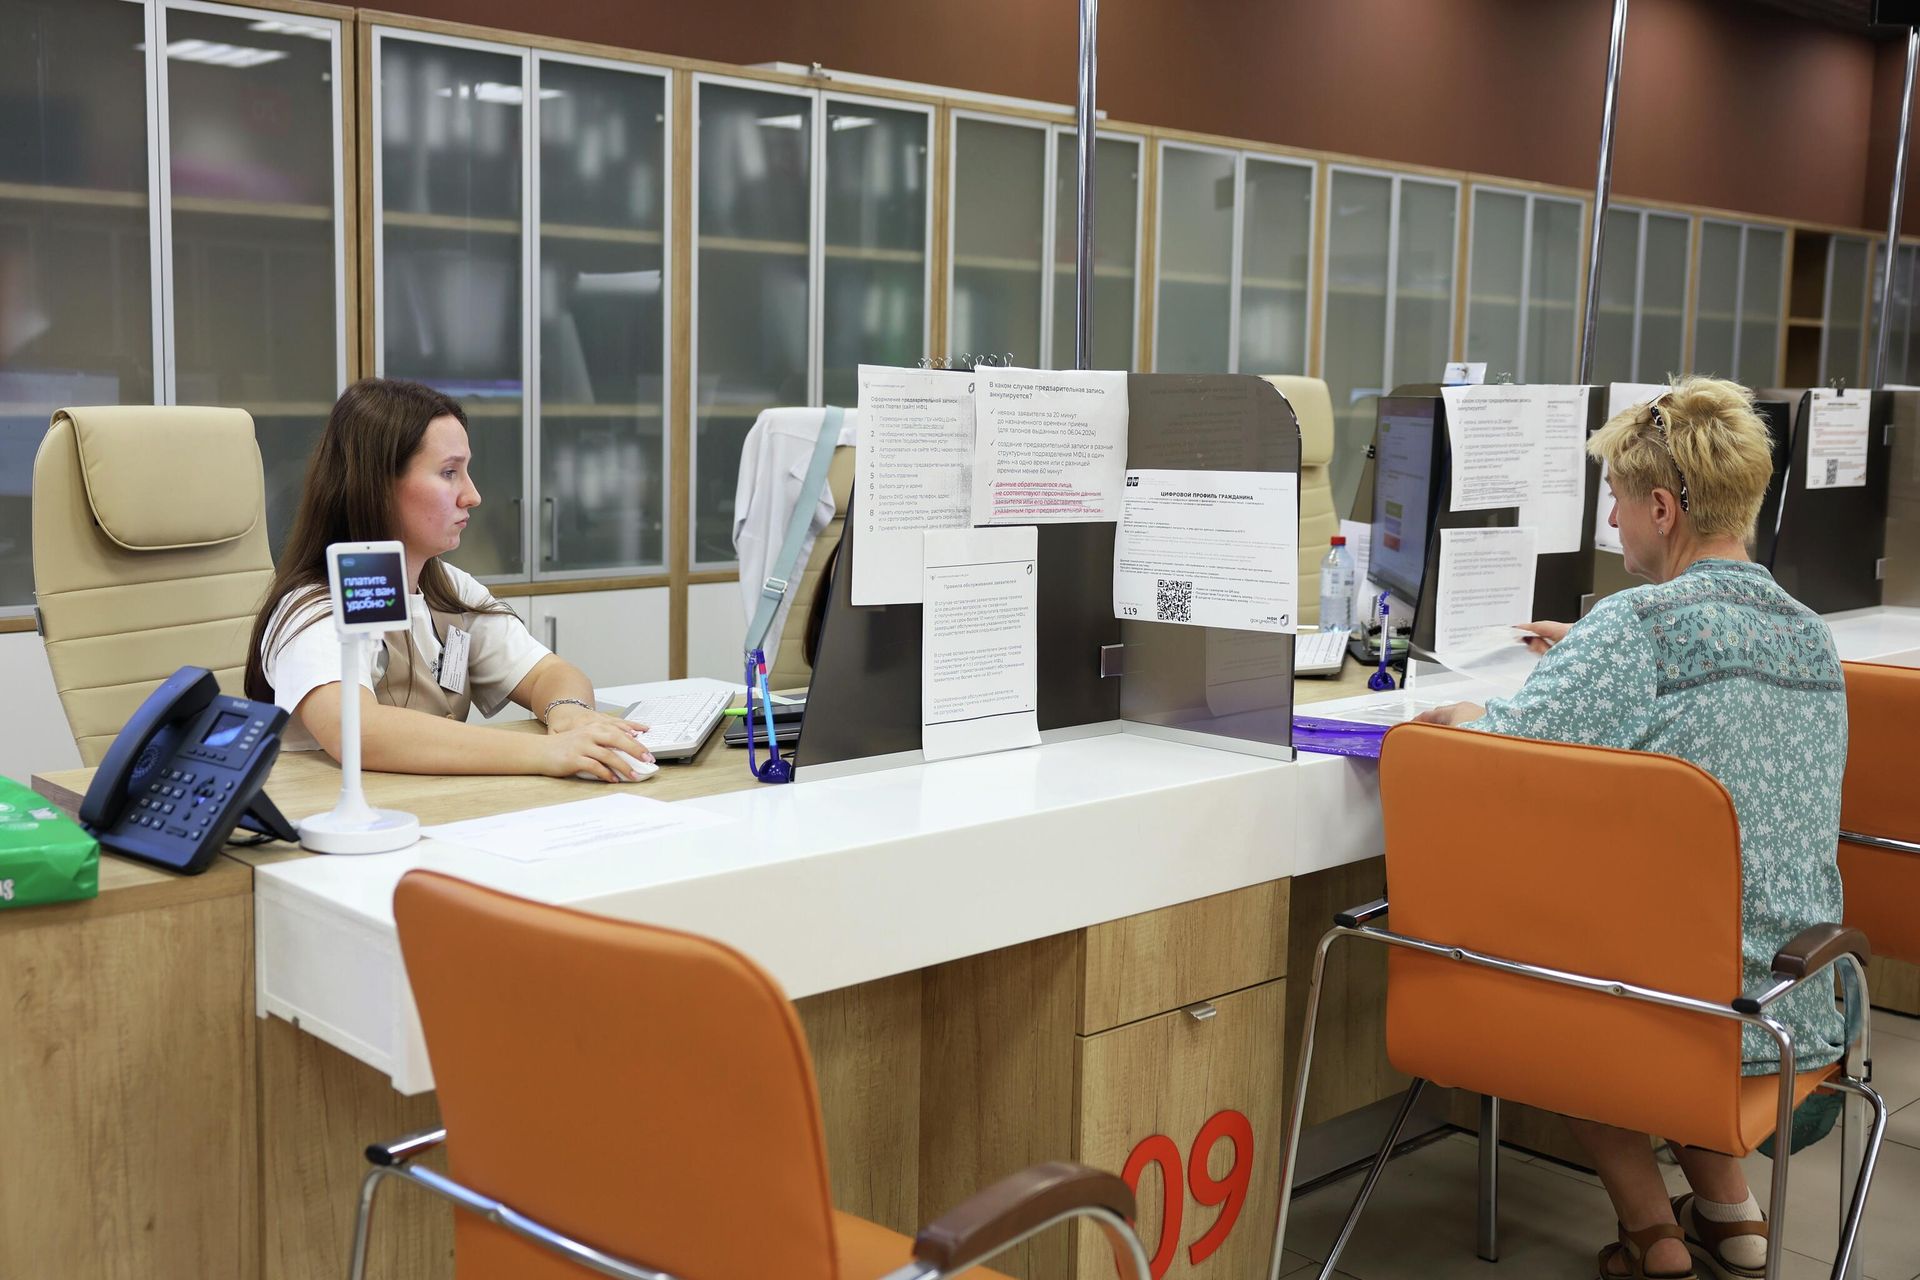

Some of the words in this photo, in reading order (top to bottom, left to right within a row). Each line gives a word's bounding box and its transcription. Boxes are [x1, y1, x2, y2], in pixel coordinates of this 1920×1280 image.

[1218, 493, 1254, 501] ГРАЖДАНИНА
[343, 575, 388, 587] платите
[354, 588, 375, 598] как
[375, 586, 397, 597] вам
[345, 596, 386, 613] удобно
[1123, 606, 1138, 616] 119
[1119, 1109, 1254, 1280] 09
